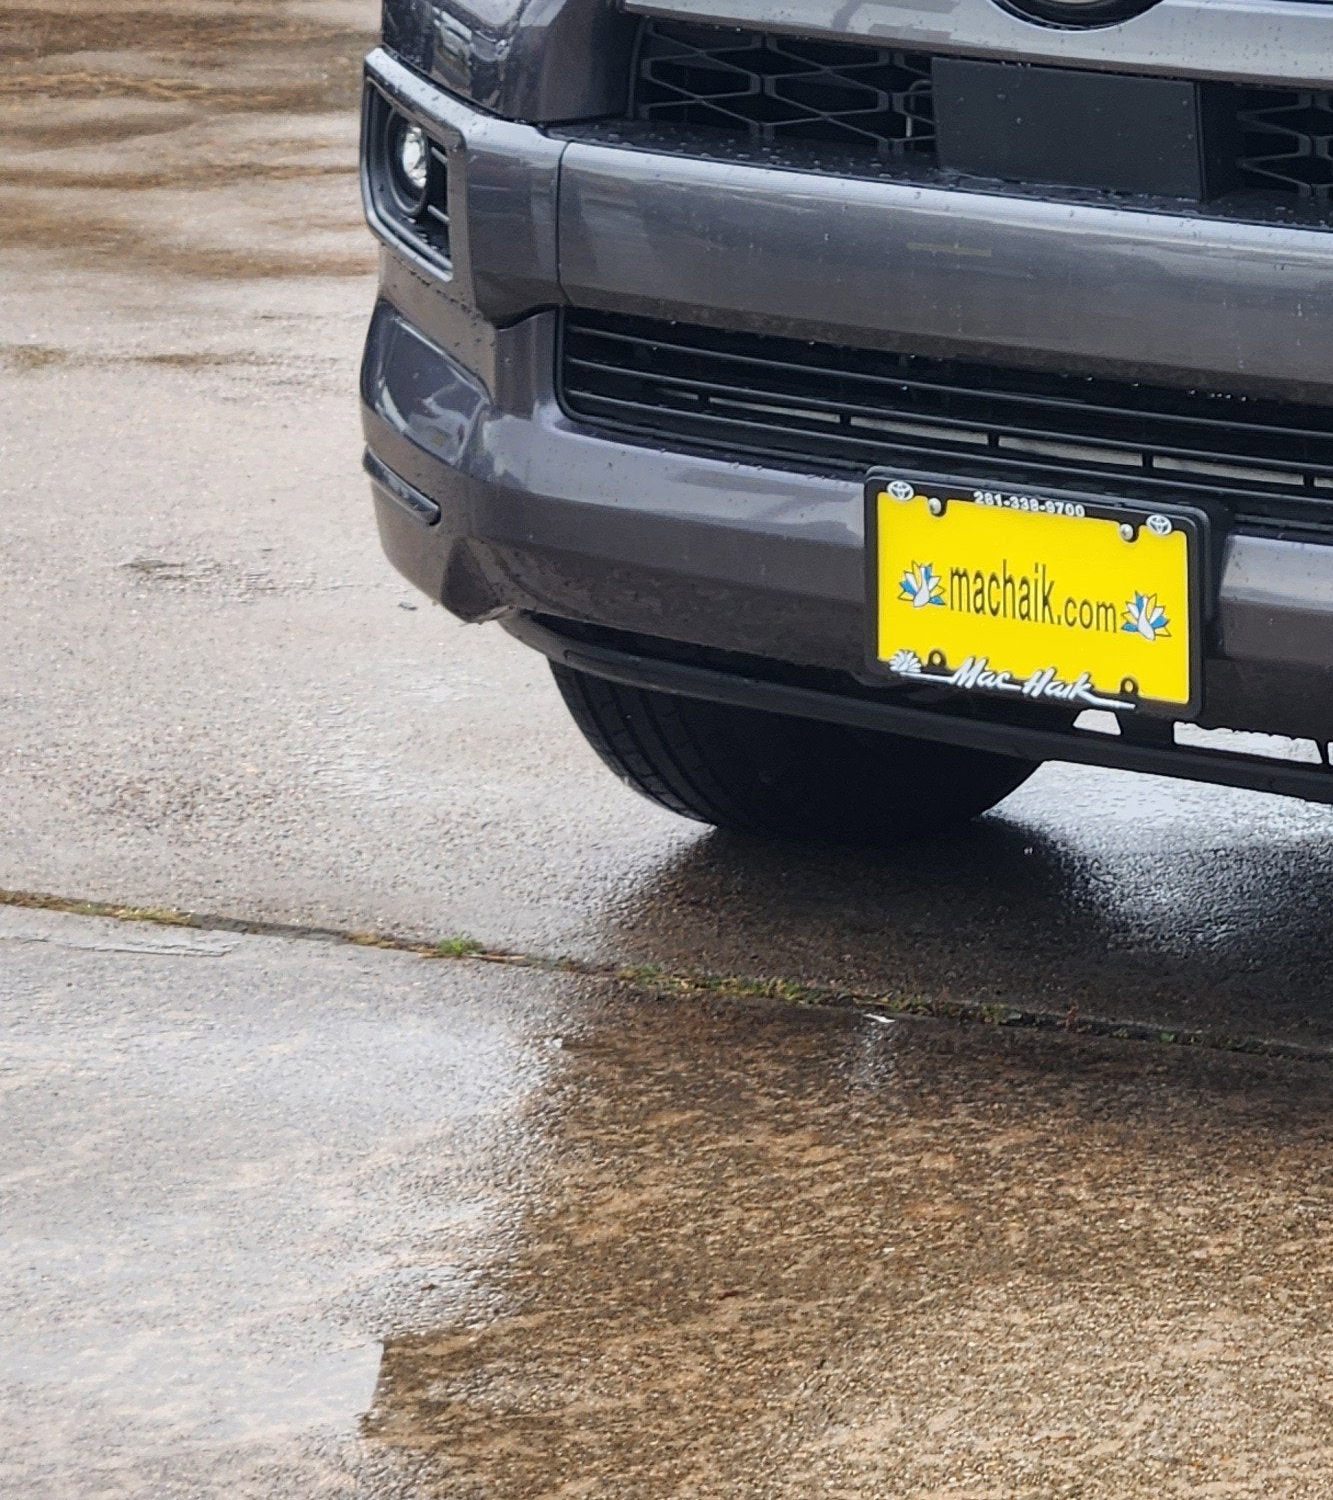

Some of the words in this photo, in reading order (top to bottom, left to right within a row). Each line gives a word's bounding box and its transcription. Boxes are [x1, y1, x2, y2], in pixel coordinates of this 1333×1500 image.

[973, 490, 1086, 518] 281-338-9700
[950, 558, 1117, 634] machaik.com
[950, 656, 1021, 690] Mac
[1022, 666, 1096, 701] Haik
